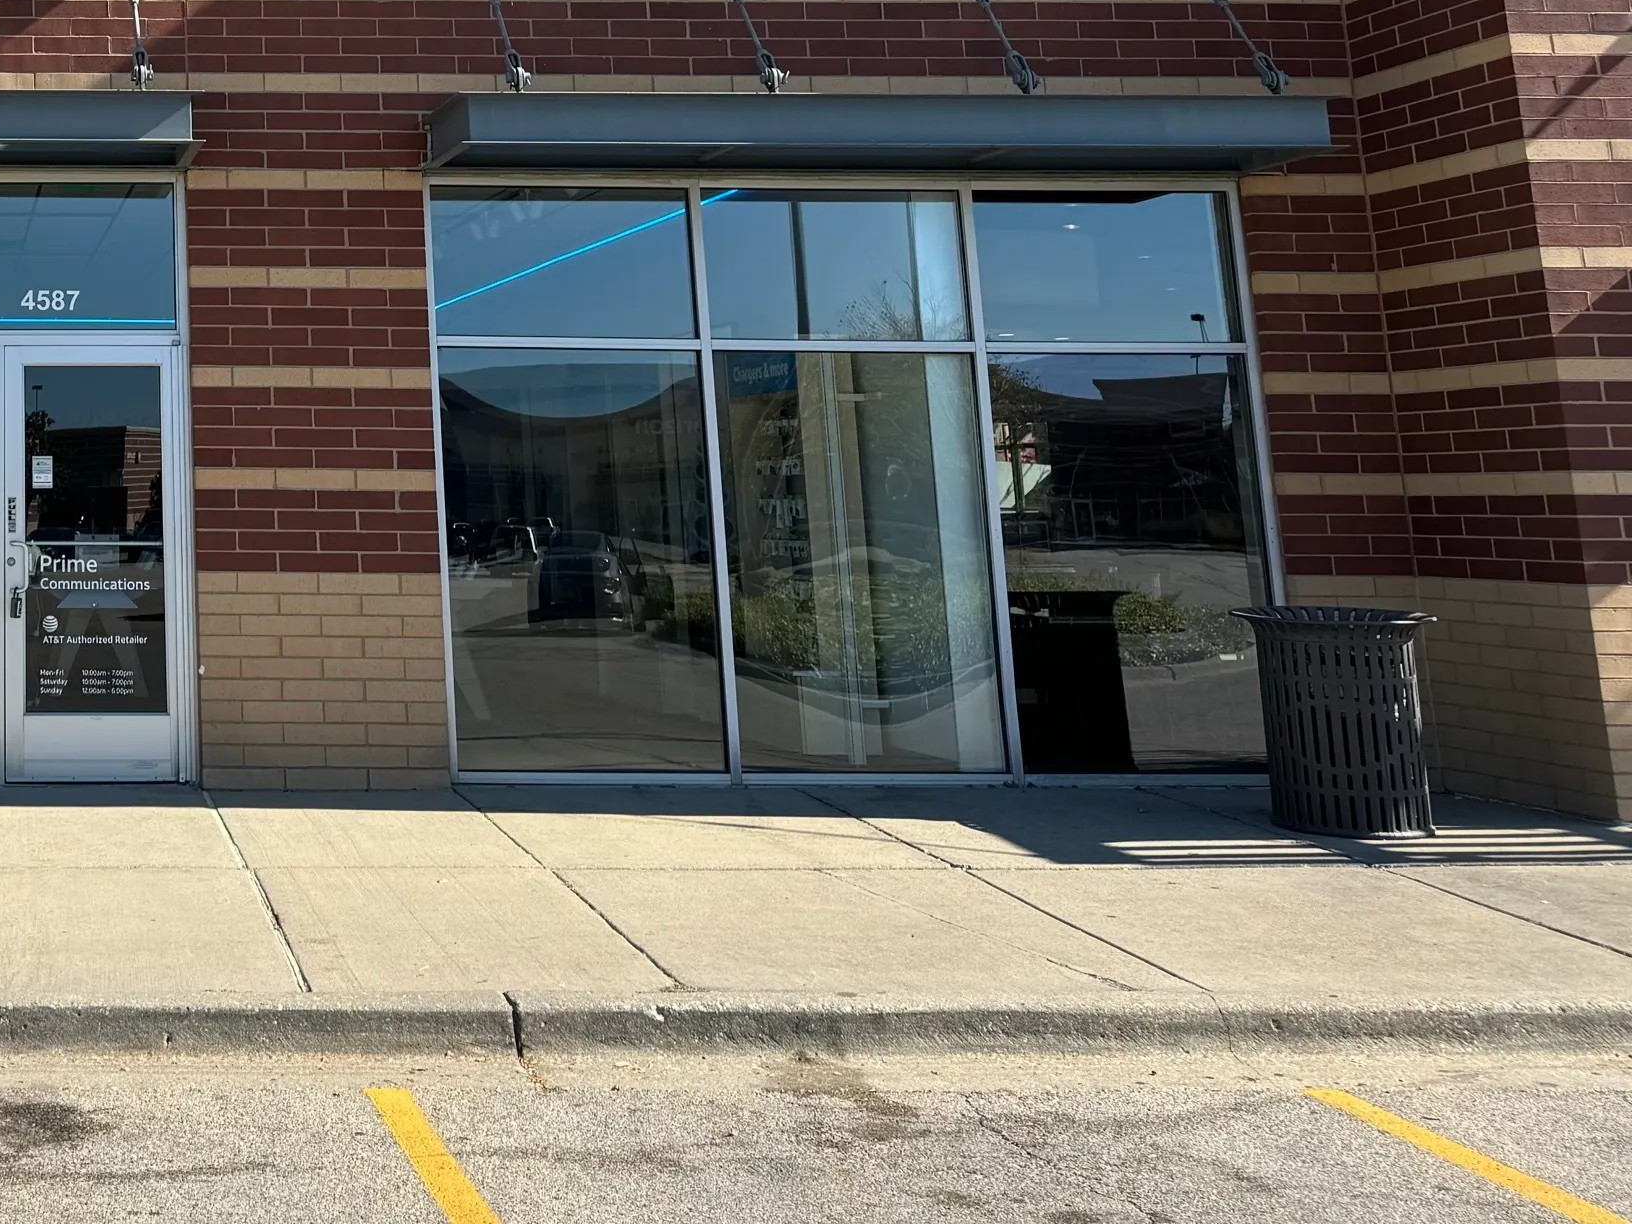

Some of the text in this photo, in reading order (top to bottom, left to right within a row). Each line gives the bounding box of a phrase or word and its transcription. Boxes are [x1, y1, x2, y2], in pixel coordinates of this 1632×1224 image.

[20, 289, 80, 311] 4587
[769, 362, 788, 378] more
[40, 554, 98, 573] Prime
[40, 578, 151, 590] Communications
[43, 635, 148, 644] AT&T Authorized Retailer
[40, 678, 68, 686] Saturday
[40, 687, 63, 695] Sunday
